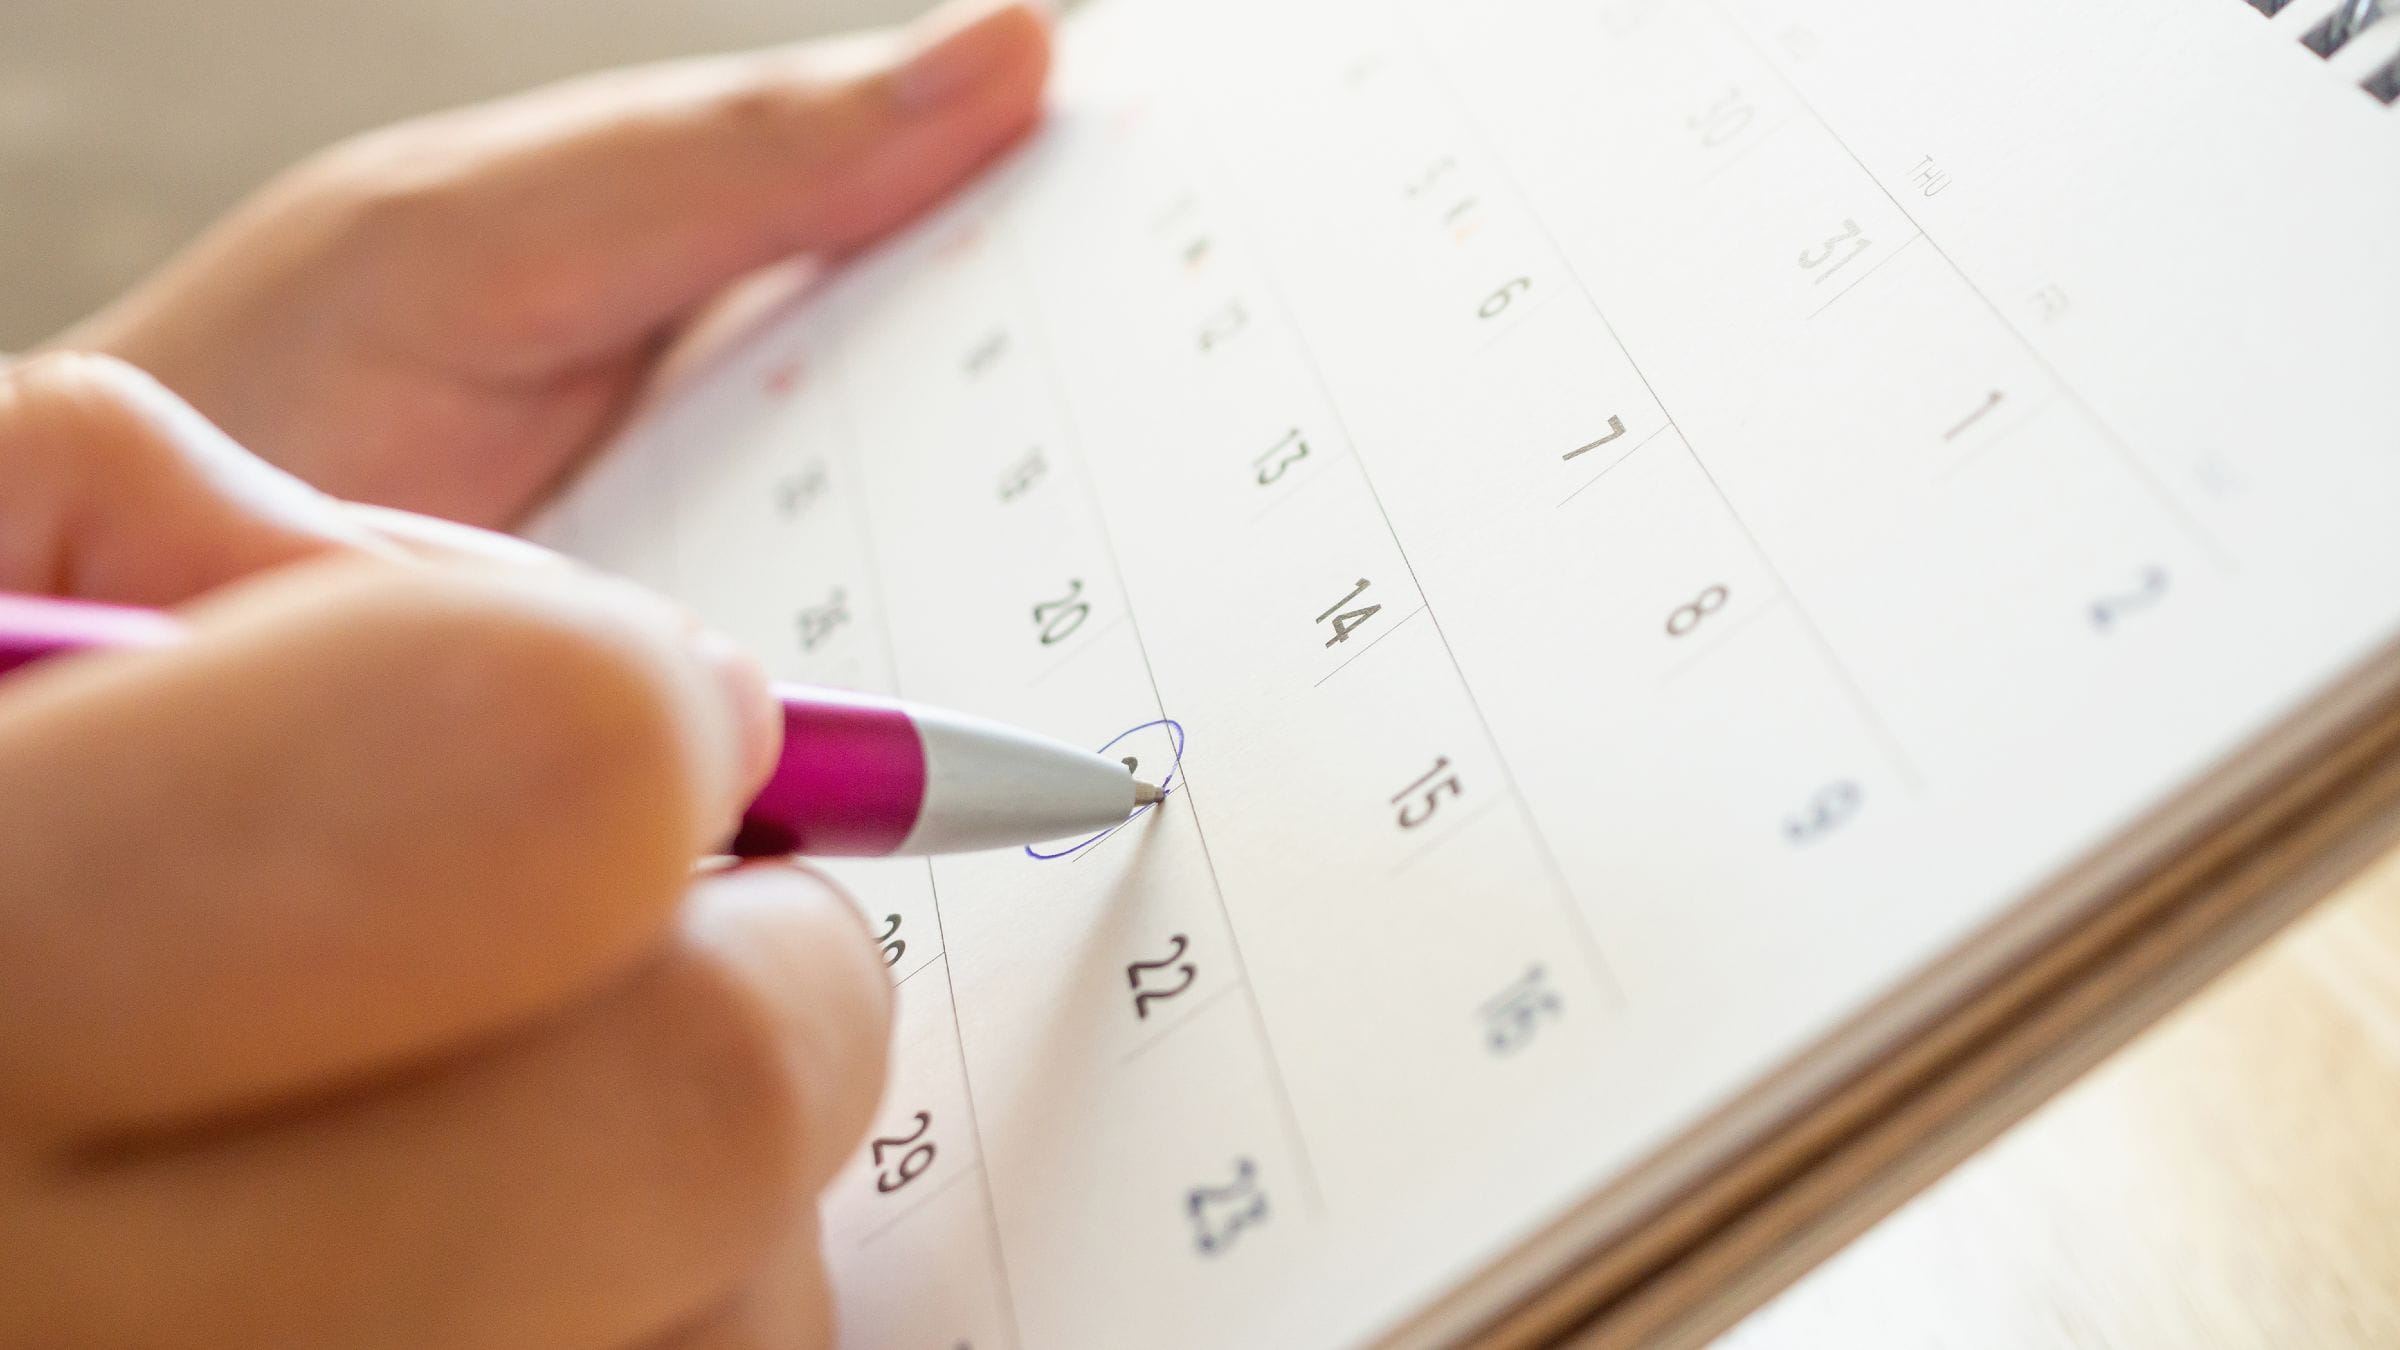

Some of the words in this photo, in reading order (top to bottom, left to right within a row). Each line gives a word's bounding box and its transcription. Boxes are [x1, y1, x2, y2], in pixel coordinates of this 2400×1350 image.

[1686, 84, 1756, 149] 30
[1907, 154, 1953, 199] THU
[1798, 218, 1873, 287] 31
[1477, 276, 1531, 320] 6
[1562, 414, 1626, 461] 7
[1943, 389, 2005, 442] 1
[1254, 428, 1310, 487] 13
[1032, 579, 1091, 647] 20
[1315, 578, 1382, 648] 14
[1665, 584, 1729, 638] 8
[1391, 756, 1462, 831] 15
[1782, 780, 1862, 844] 9
[1125, 934, 1197, 1020] 22
[1479, 962, 1563, 1057] 16
[870, 1110, 937, 1195] 29
[1184, 1157, 1269, 1257] 23
